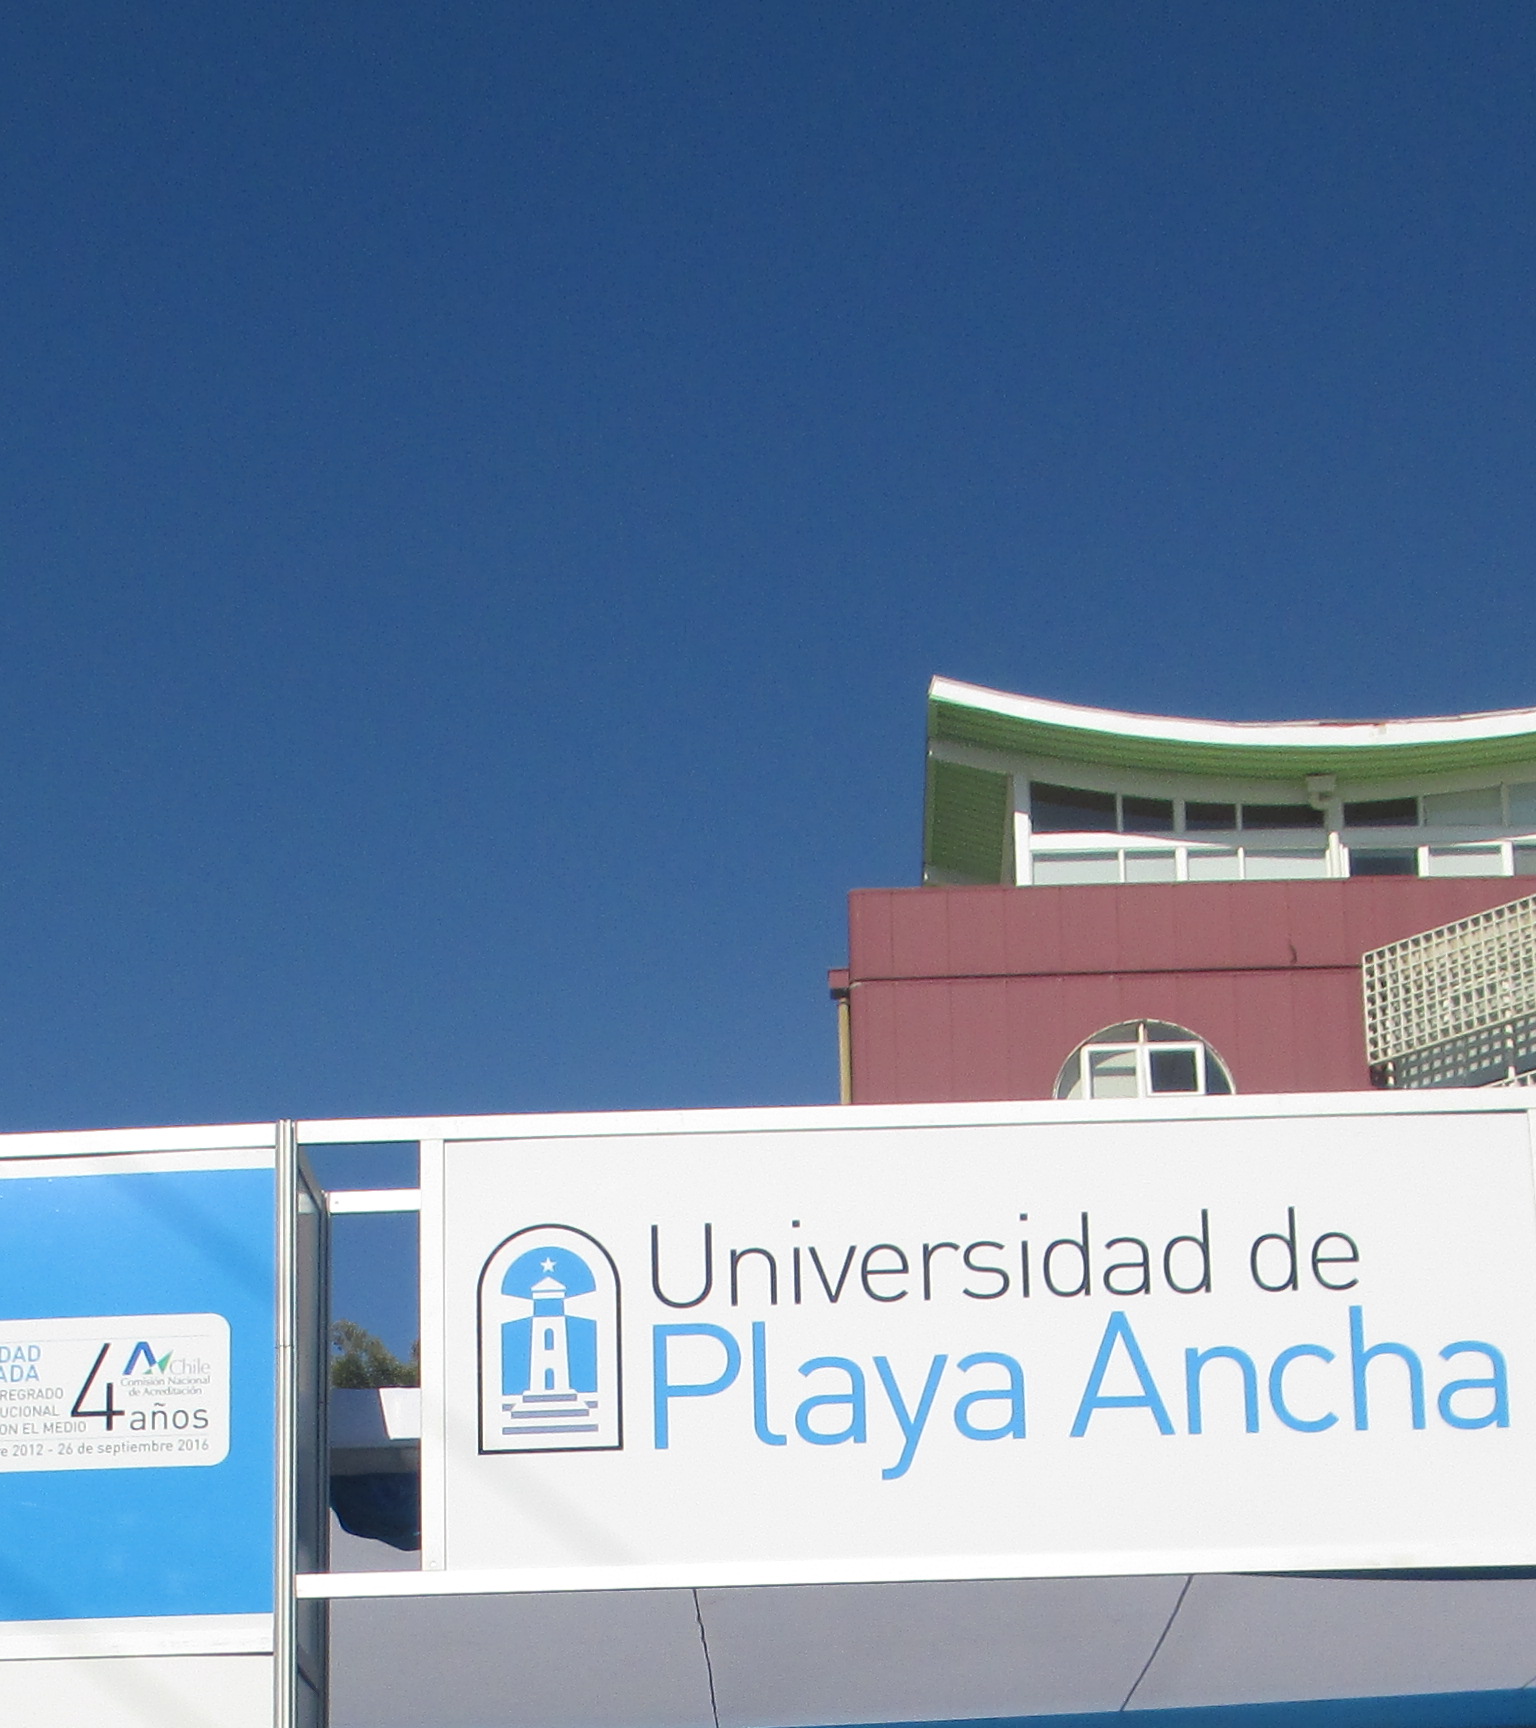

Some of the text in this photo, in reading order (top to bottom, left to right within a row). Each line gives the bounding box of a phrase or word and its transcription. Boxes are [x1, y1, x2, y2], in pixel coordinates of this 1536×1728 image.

[651, 1206, 1360, 1309] Universidad de
[70, 1342, 209, 1431] 4 años
[169, 1358, 211, 1375] Chile
[653, 1305, 1511, 1480] Playa Ancha
[13, 1443, 44, 1457] 2012
[58, 1442, 73, 1455] 26
[77, 1442, 94, 1454] de
[98, 1438, 174, 1455] septiembre
[177, 1438, 209, 1451] 2016
[22, 1423, 39, 1435] EL
[43, 1421, 87, 1434] MEDIO
